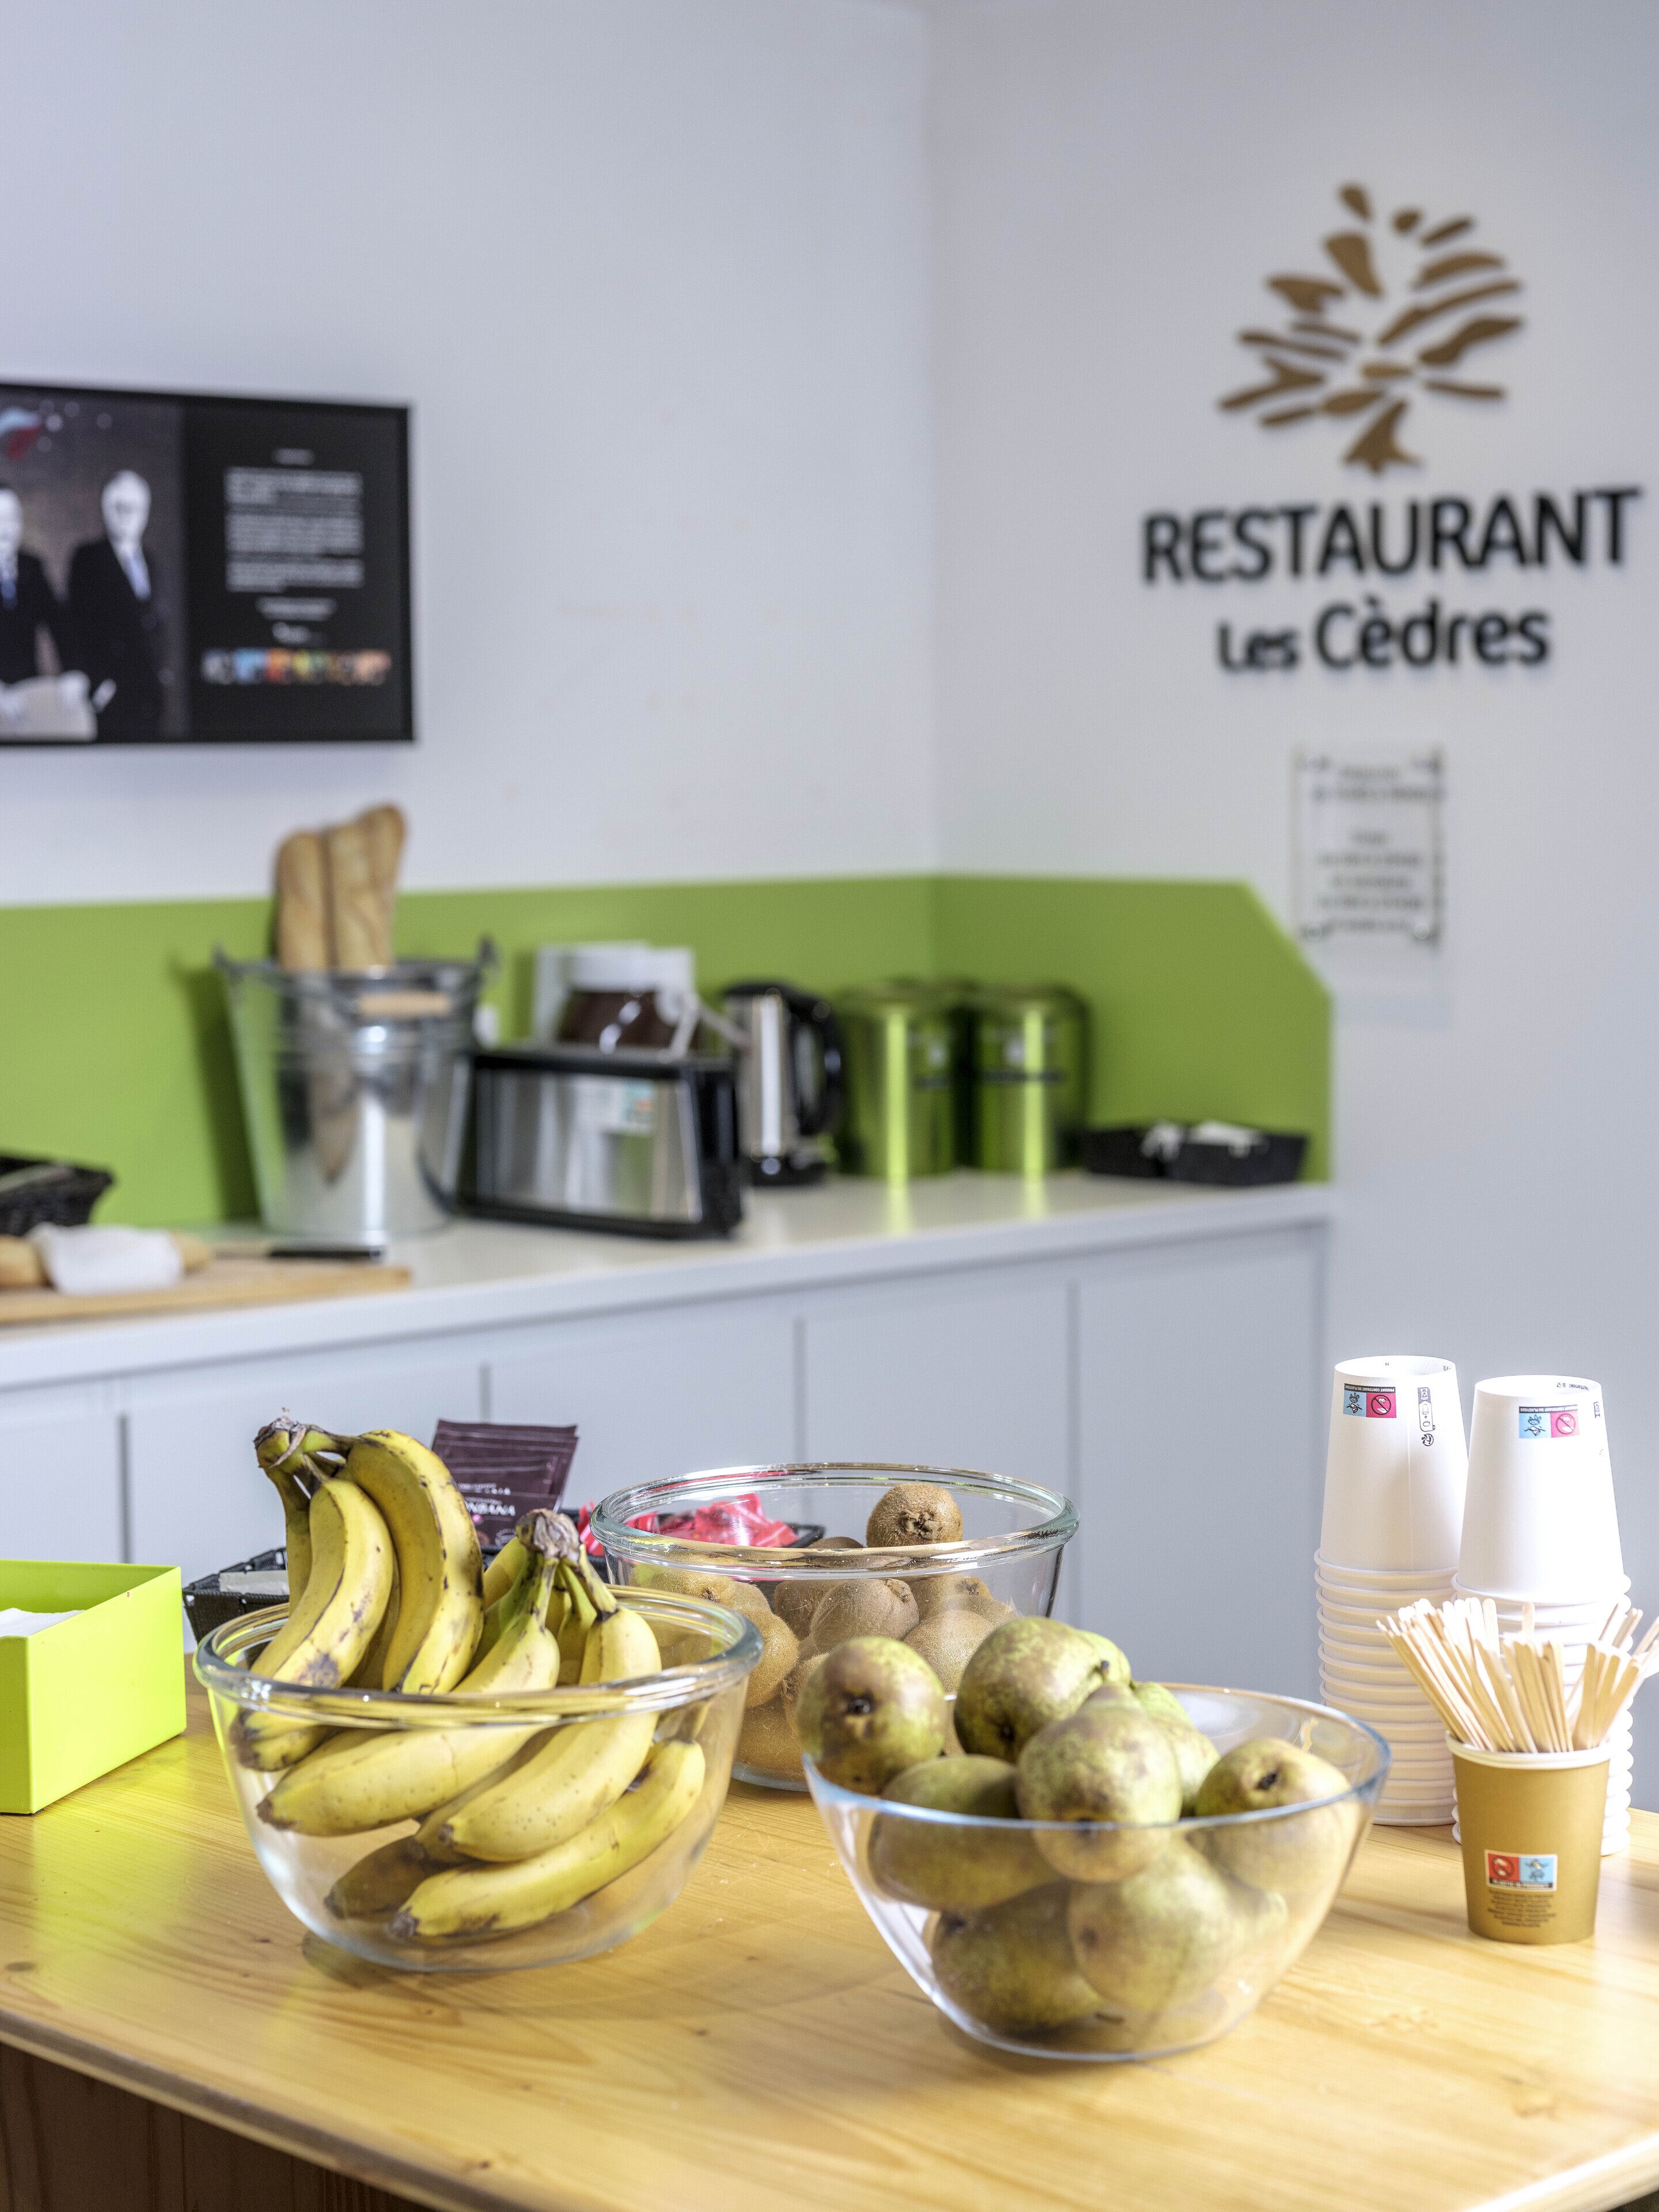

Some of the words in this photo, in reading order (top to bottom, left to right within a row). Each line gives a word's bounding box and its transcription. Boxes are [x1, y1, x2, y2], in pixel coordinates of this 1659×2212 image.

[1142, 487, 1642, 585] RESTAURANT
[1218, 621, 1300, 672] Les
[1315, 594, 1550, 669] Cèdres
